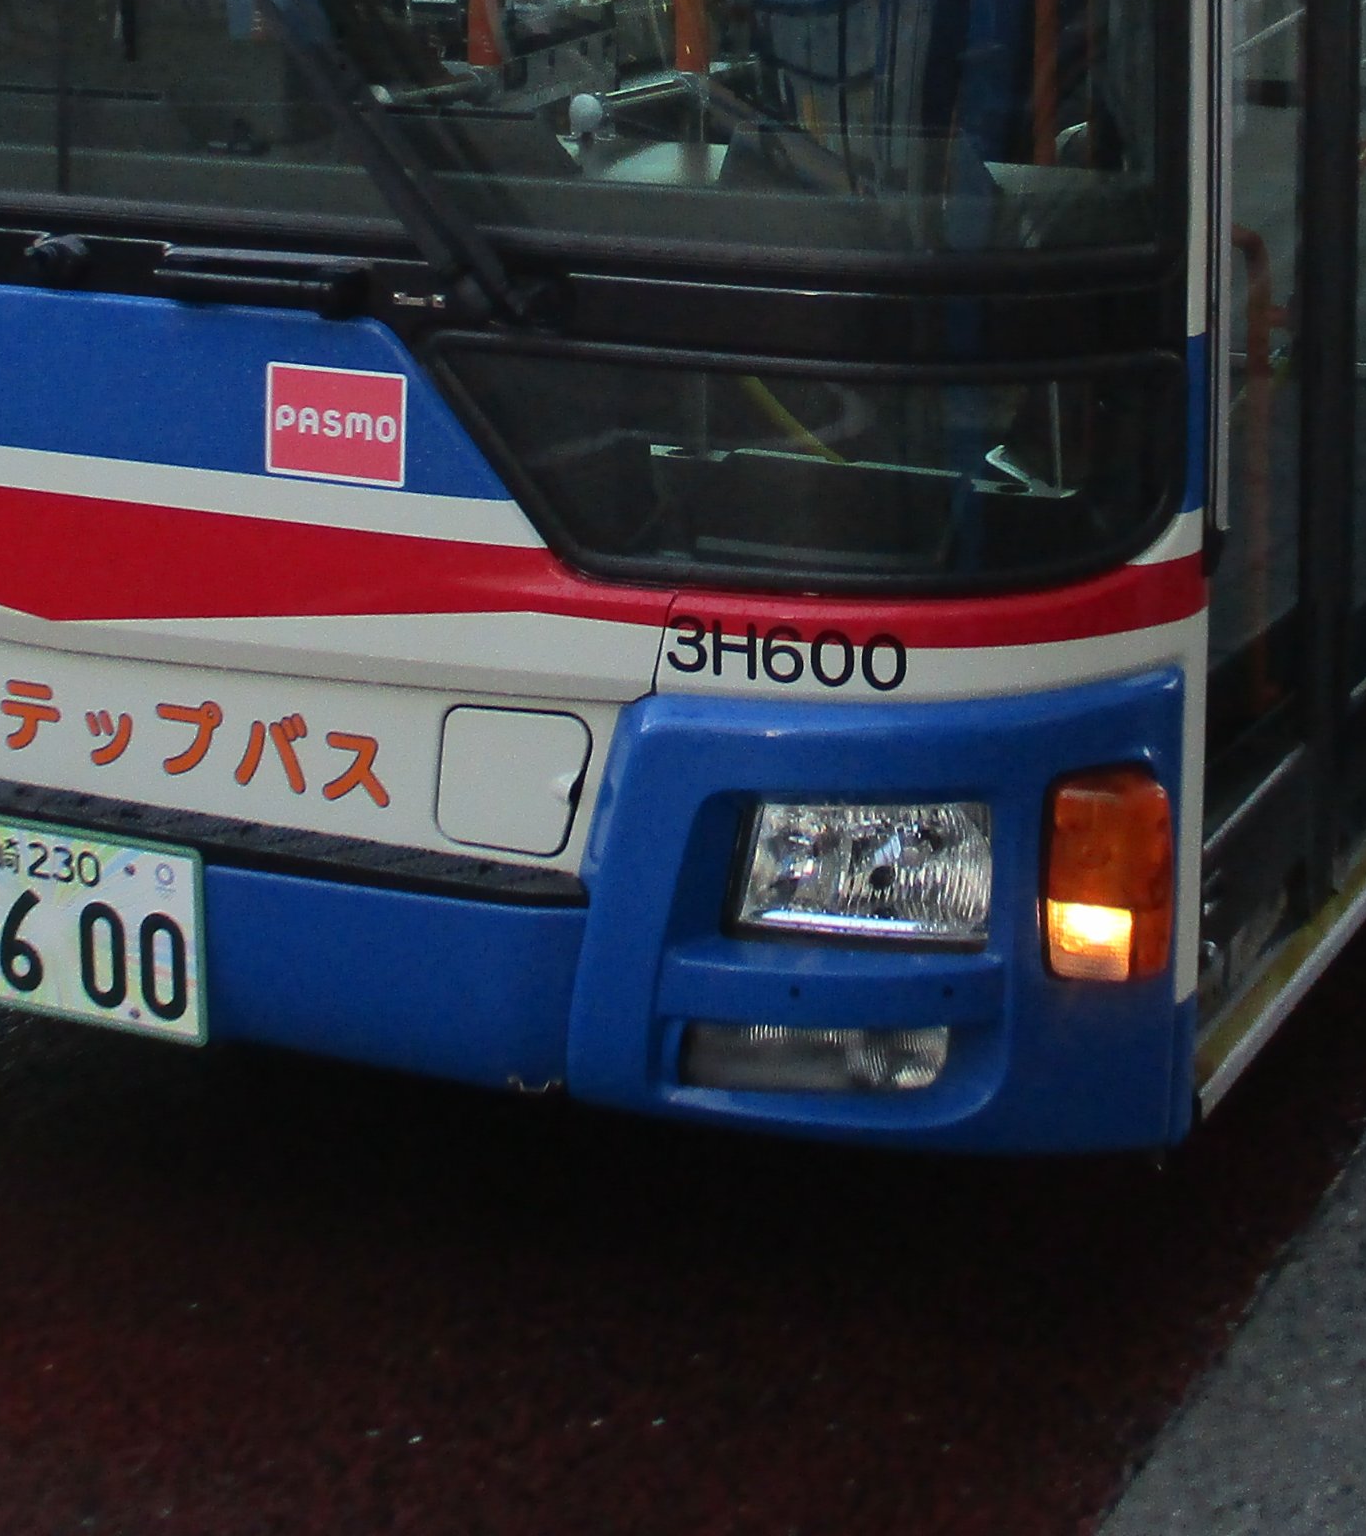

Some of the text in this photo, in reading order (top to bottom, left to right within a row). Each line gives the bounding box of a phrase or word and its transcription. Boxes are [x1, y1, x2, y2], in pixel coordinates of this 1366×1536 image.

[275, 404, 397, 443] PASMO
[667, 615, 907, 691] 3H600
[27, 841, 100, 887] 230
